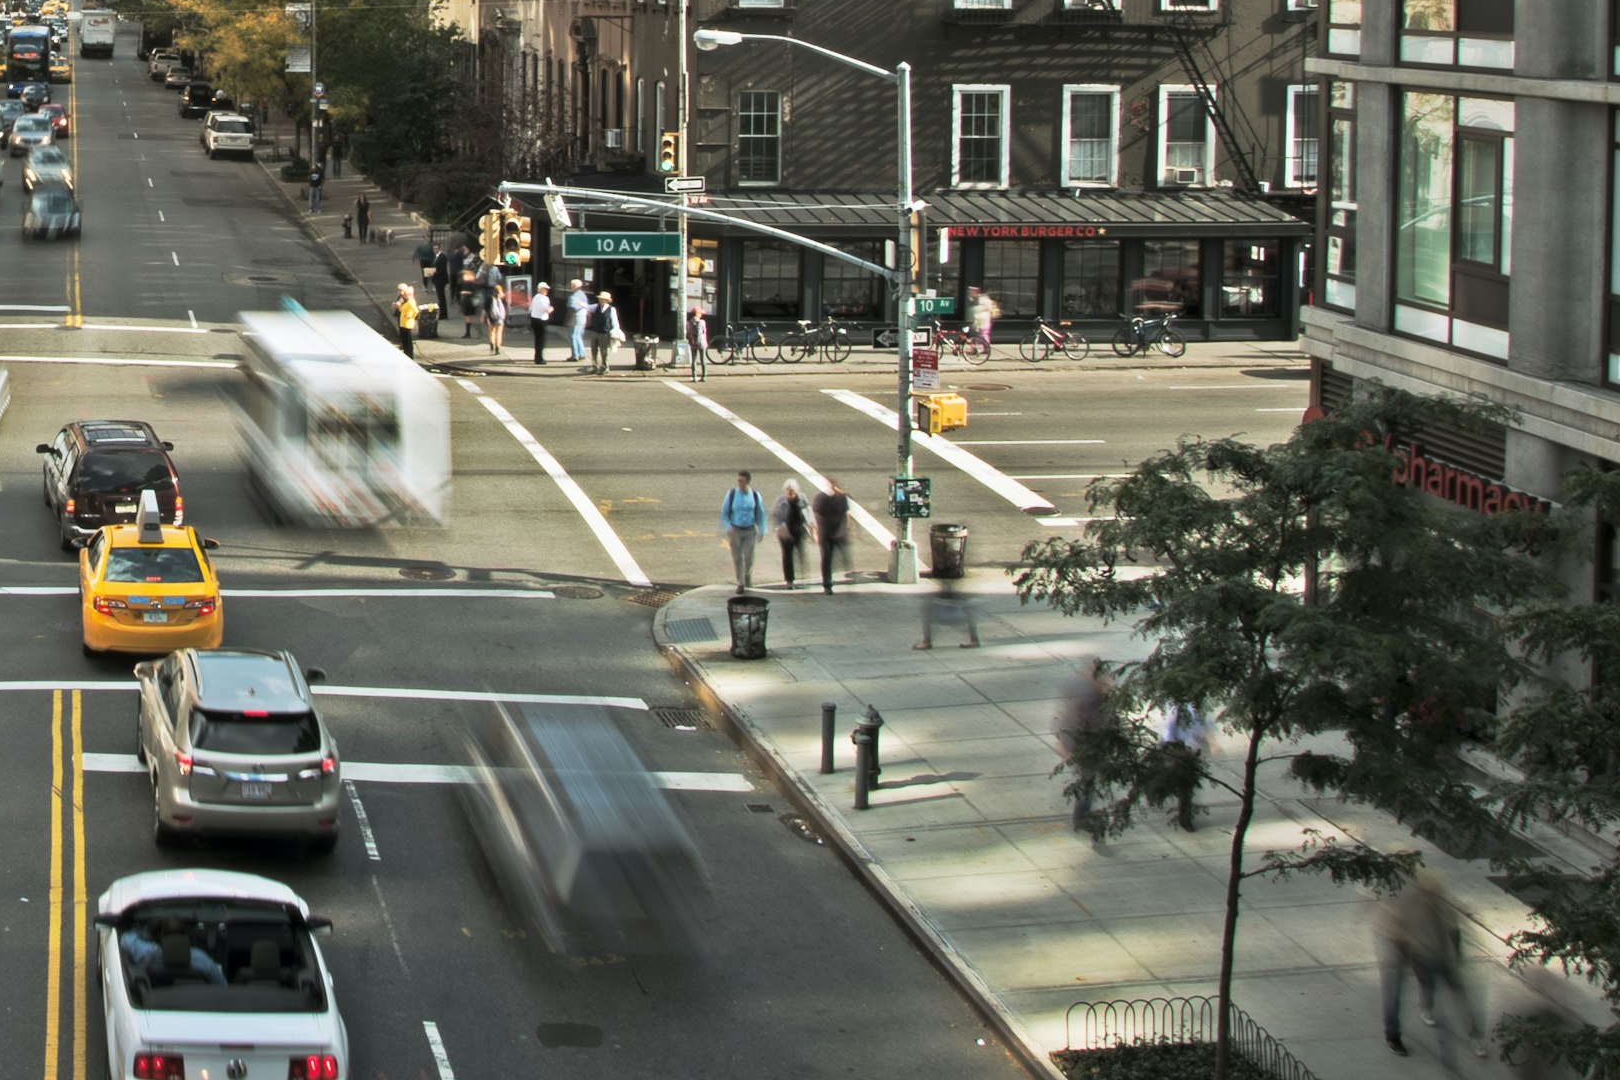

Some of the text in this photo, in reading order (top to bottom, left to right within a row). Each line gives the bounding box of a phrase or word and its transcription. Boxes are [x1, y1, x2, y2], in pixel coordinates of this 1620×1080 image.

[948, 226, 1096, 237] NEW YORK BURGER CO
[596, 239, 642, 252] 10 Av
[920, 300, 934, 312] 10
